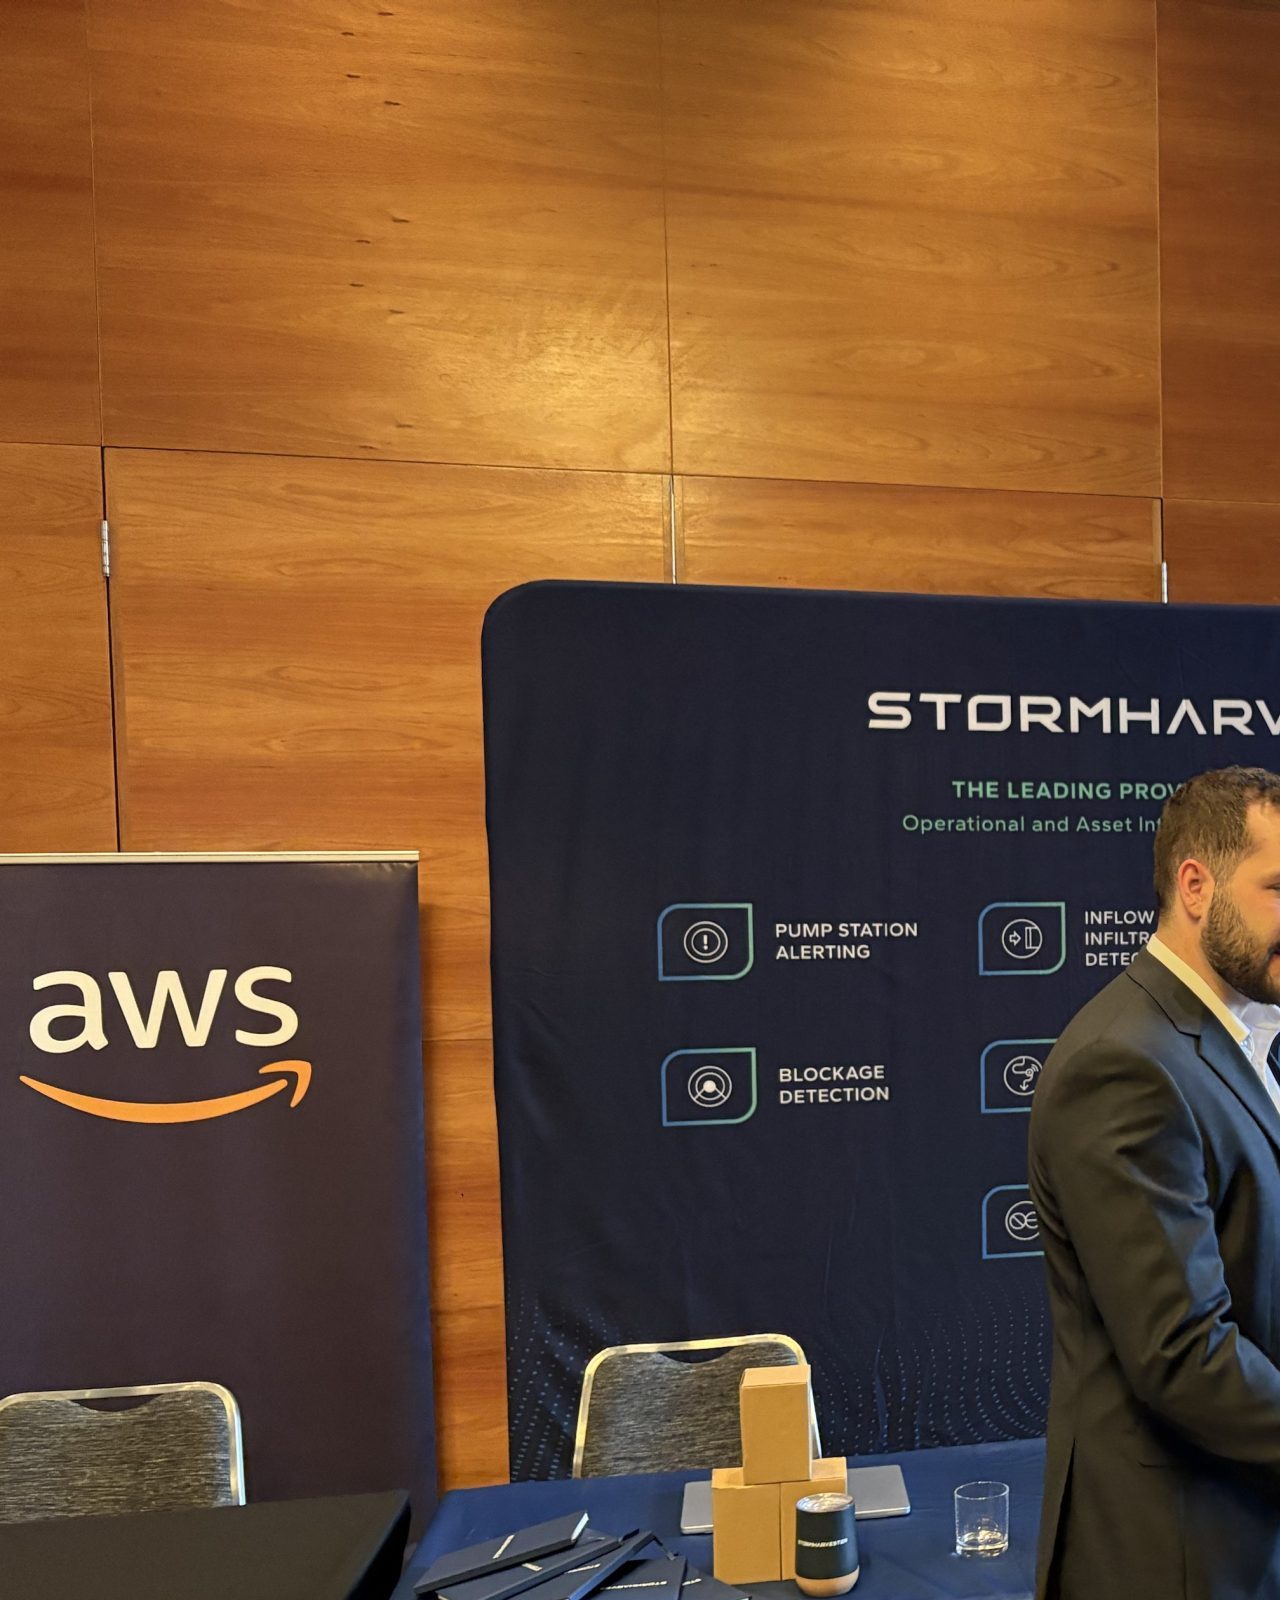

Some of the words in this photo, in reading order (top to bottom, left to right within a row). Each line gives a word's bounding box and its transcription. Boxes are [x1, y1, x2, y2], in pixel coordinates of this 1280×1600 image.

[951, 780, 999, 799] THE
[1007, 781, 1112, 800] LEADING
[1119, 782, 1183, 800] PROV
[902, 814, 1025, 835] Operational
[1031, 815, 1069, 833] and
[1075, 815, 1133, 833] Asset
[1138, 815, 1161, 833] Int
[1084, 910, 1155, 925] INFLOW
[775, 923, 833, 938] PUMP
[838, 922, 918, 938] STATION
[1084, 931, 1149, 946] INFILTR
[775, 944, 871, 960] ALERTING
[29, 965, 299, 1054] aws
[779, 1064, 885, 1083] BLOCKAGE
[779, 1086, 890, 1105] DETECTION
